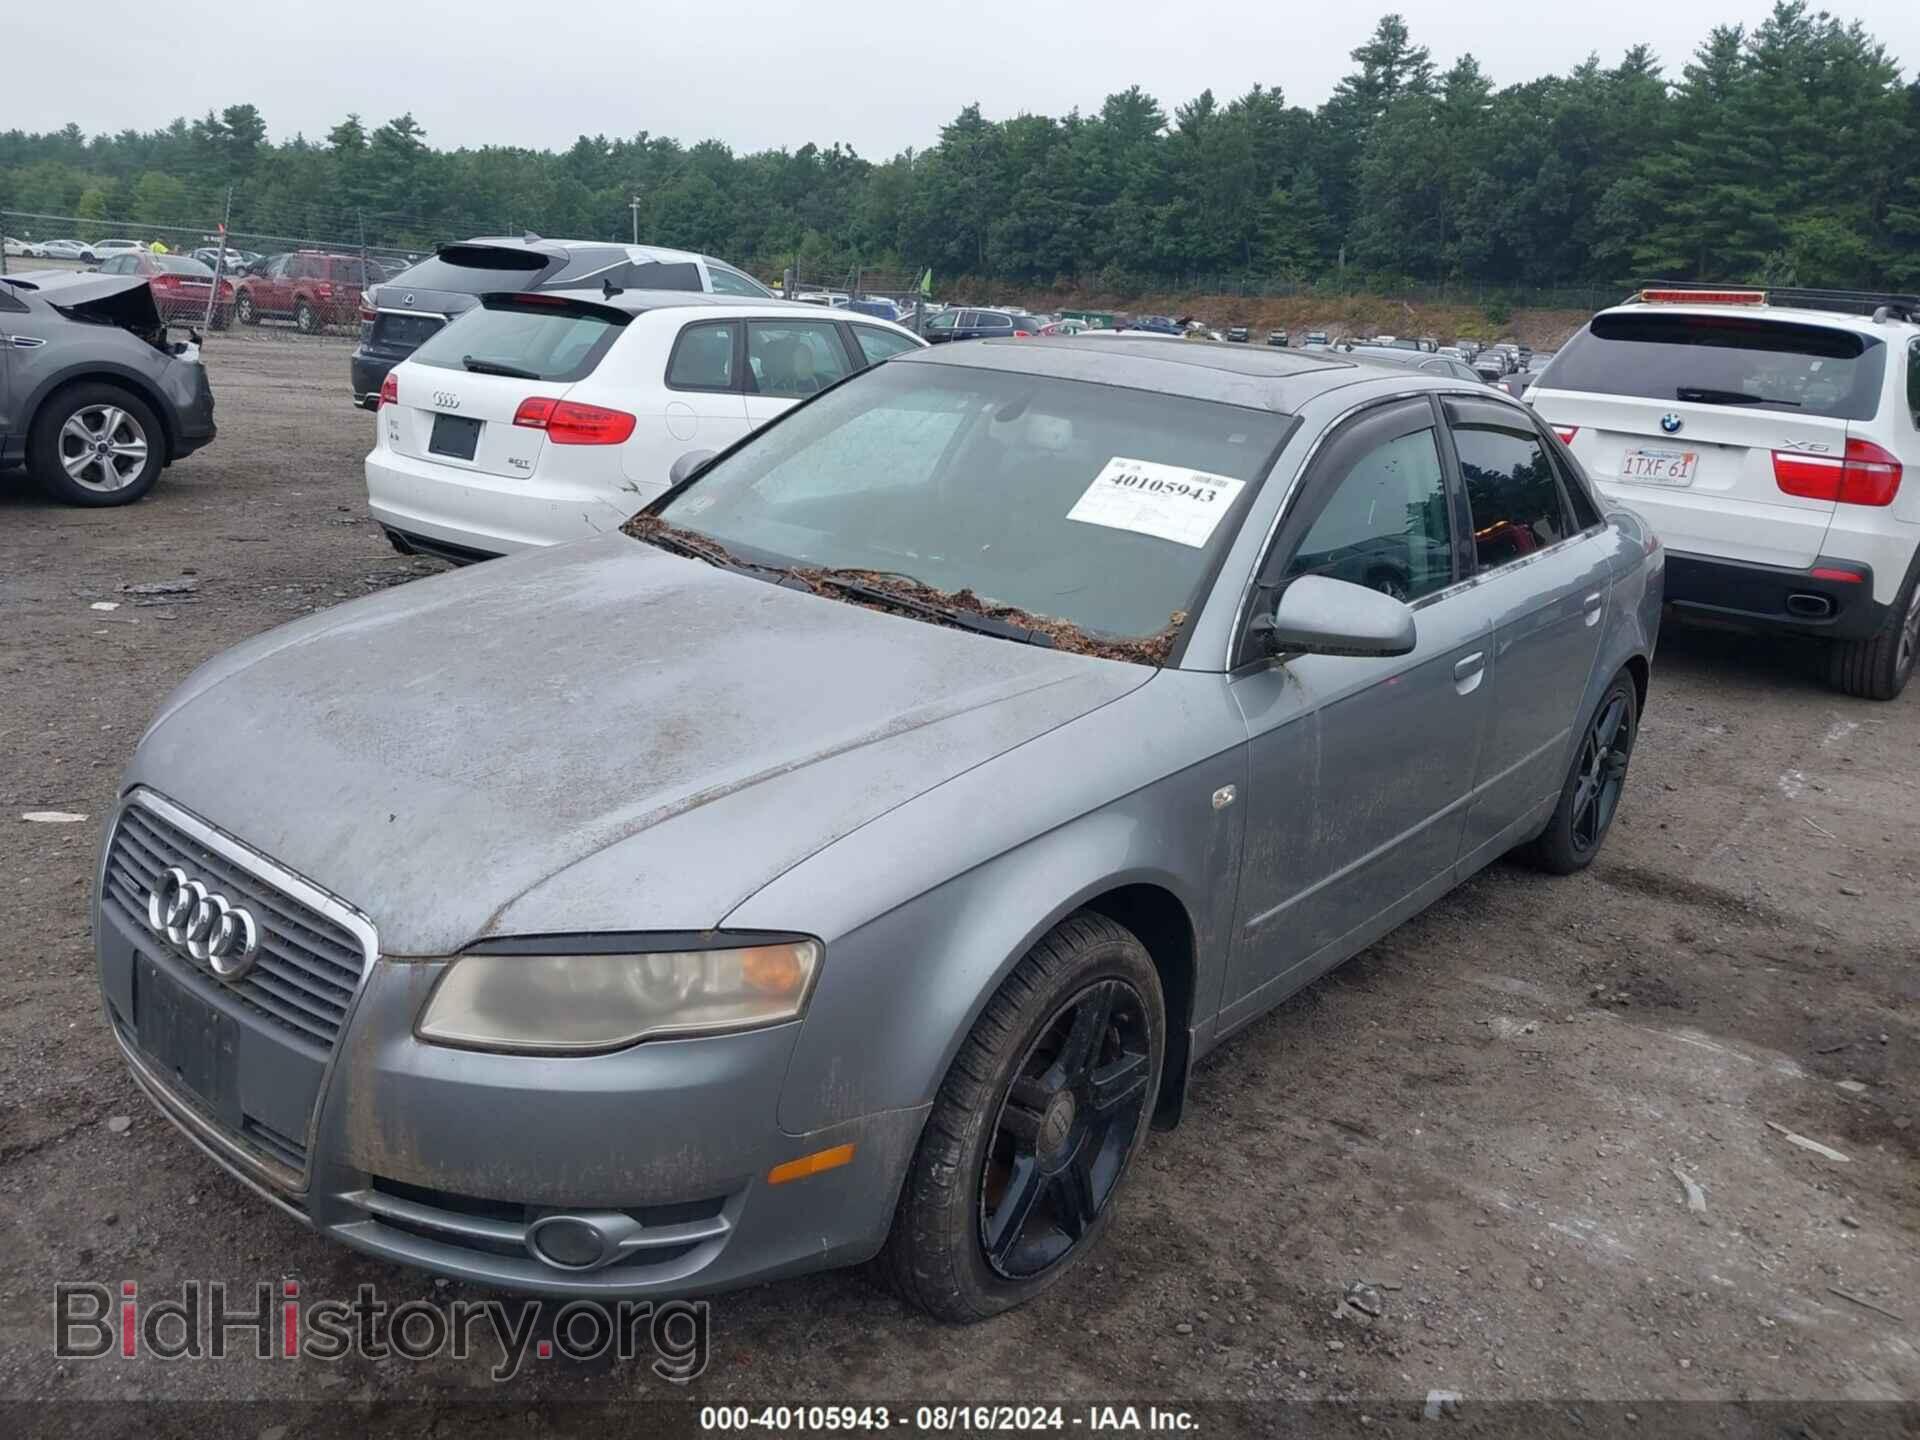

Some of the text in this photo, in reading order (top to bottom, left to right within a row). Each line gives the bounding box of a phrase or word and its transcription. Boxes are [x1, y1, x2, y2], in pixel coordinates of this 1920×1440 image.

[1623, 457, 1689, 478] 1TXF 61
[1110, 472, 1217, 503] 40105943
